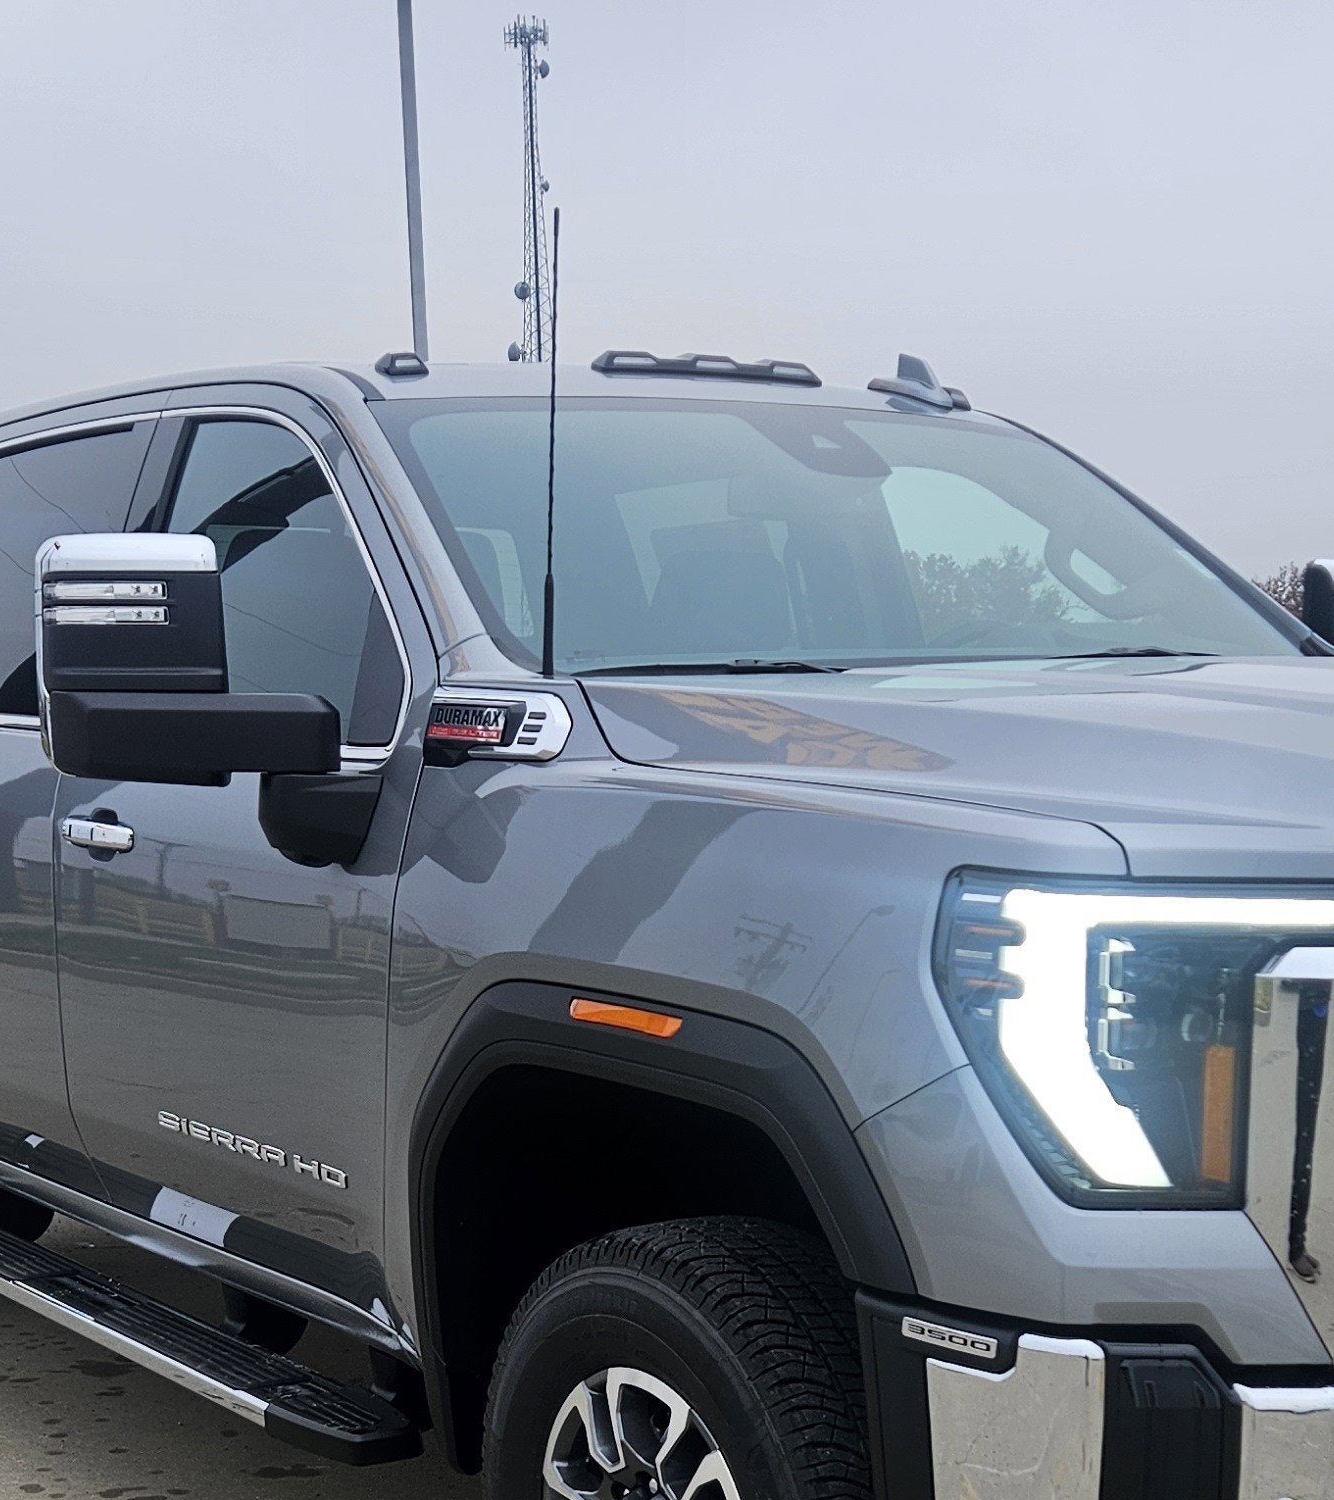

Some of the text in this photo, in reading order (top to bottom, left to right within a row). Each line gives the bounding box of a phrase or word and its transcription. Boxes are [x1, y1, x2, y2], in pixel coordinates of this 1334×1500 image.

[435, 707, 501, 727] DURAMAX
[158, 1110, 349, 1189] SIERRA HD
[908, 1323, 991, 1352] 3500
